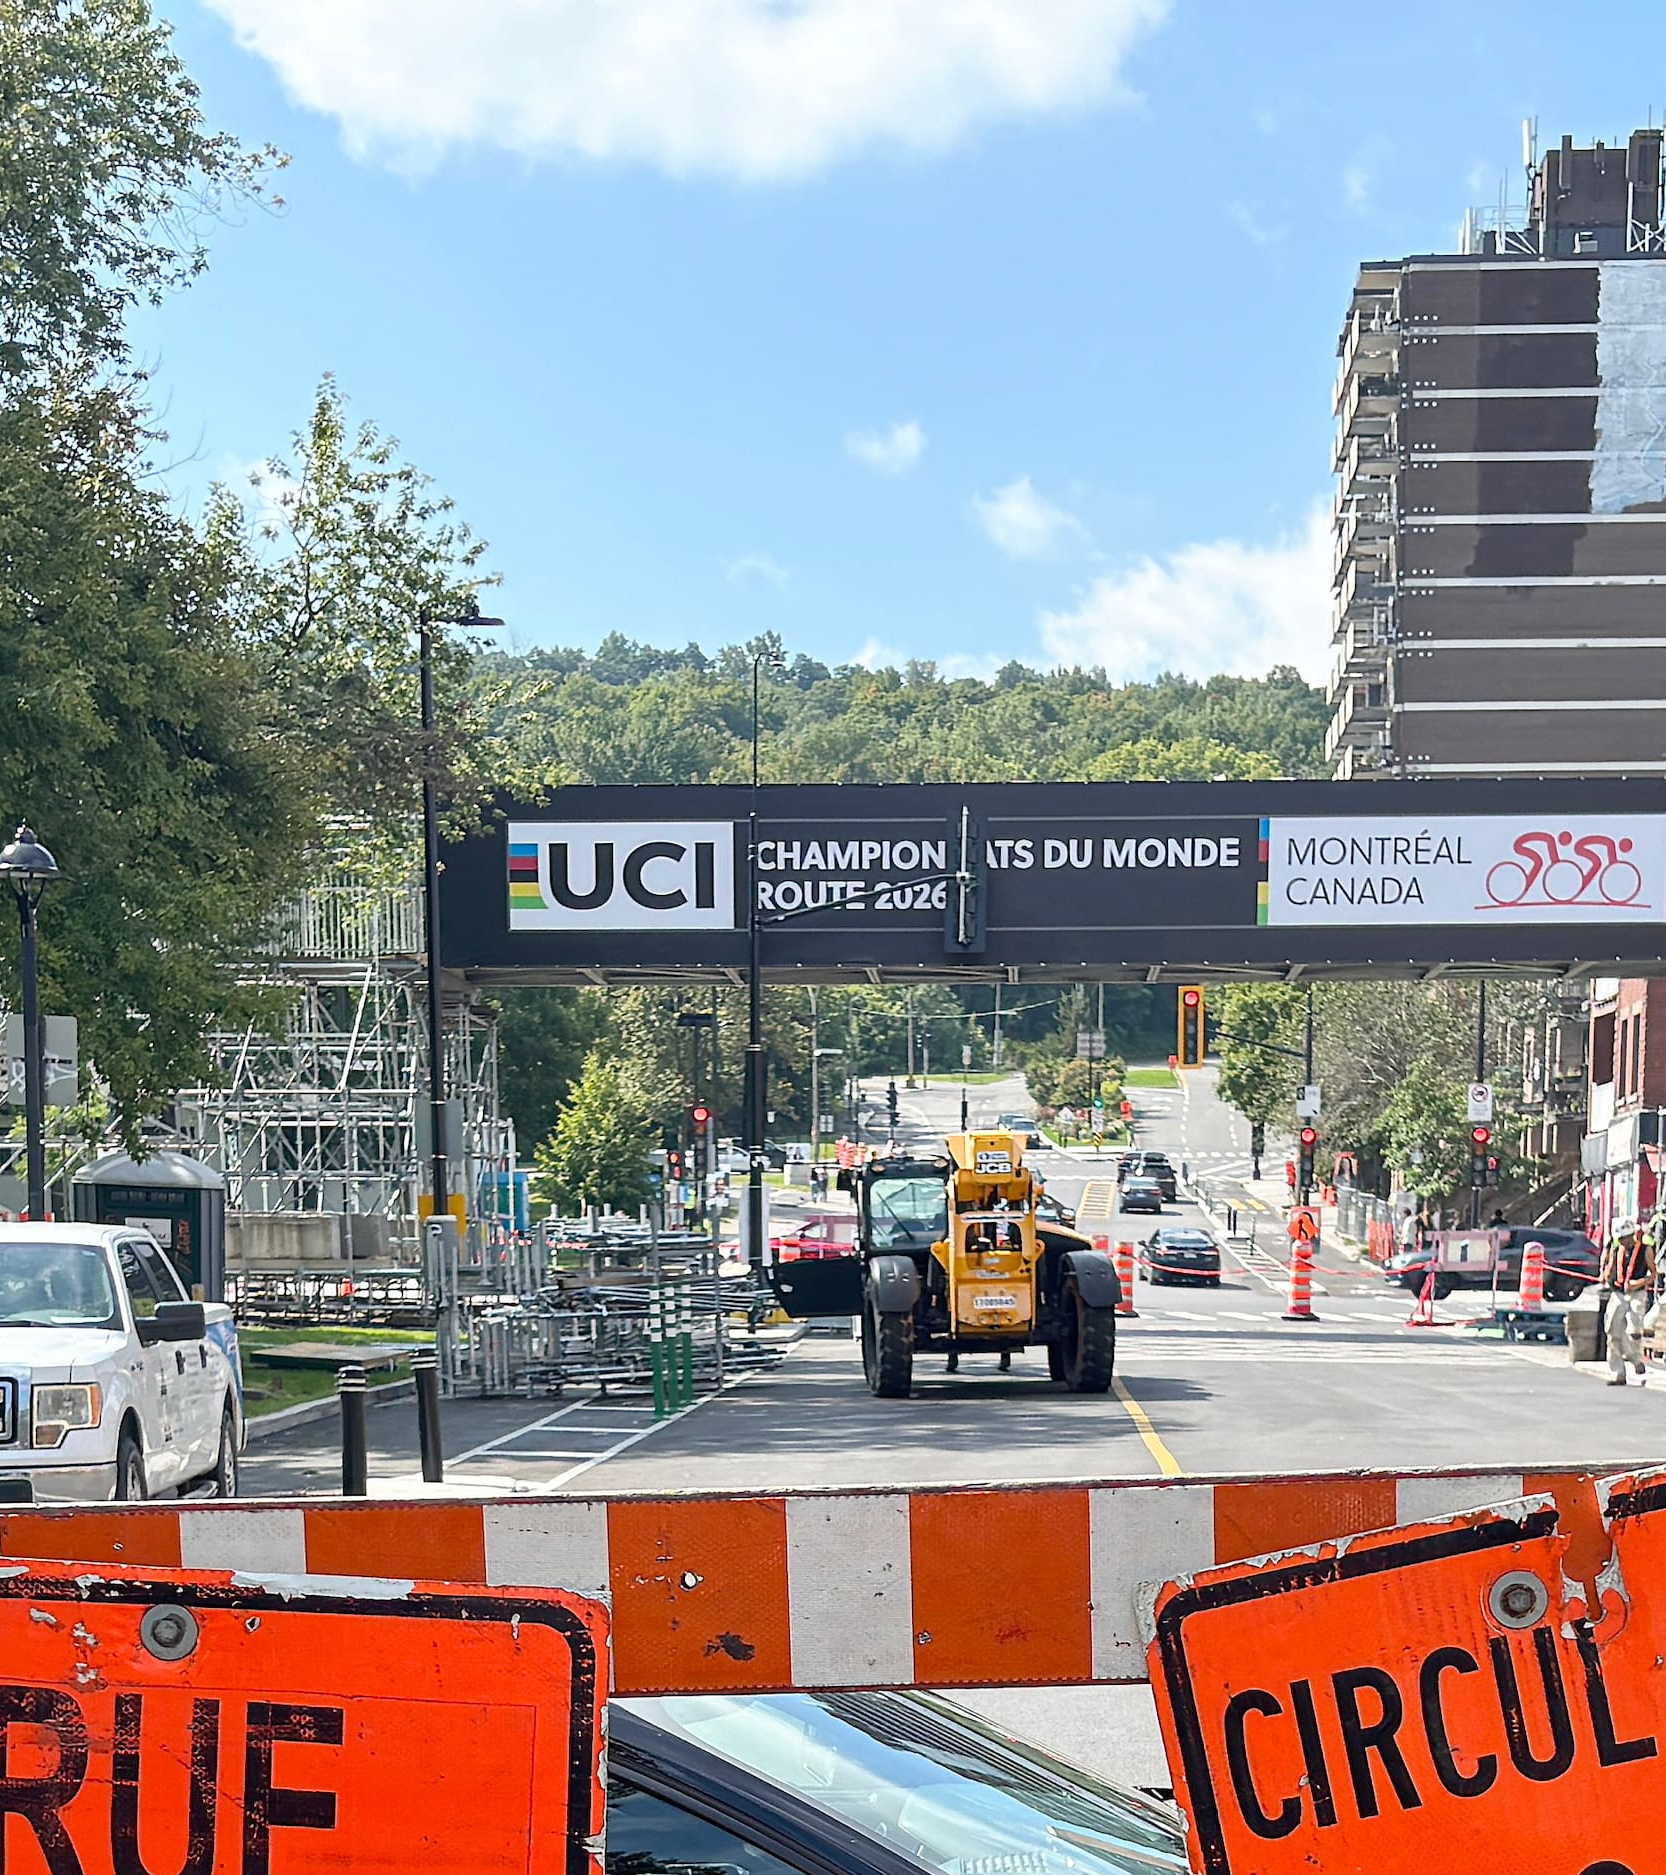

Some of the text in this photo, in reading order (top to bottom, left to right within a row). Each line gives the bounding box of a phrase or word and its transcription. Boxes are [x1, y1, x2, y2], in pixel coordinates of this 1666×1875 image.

[1044, 839, 1093, 869] DU
[1103, 837, 1240, 868] MONDE
[1286, 829, 1472, 866] MONTRÉAL
[548, 841, 715, 910] UCI
[1286, 876, 1425, 906] CANADA
[757, 880, 947, 910] ROUTE 2026
[976, 1163, 1012, 1174] JCB
